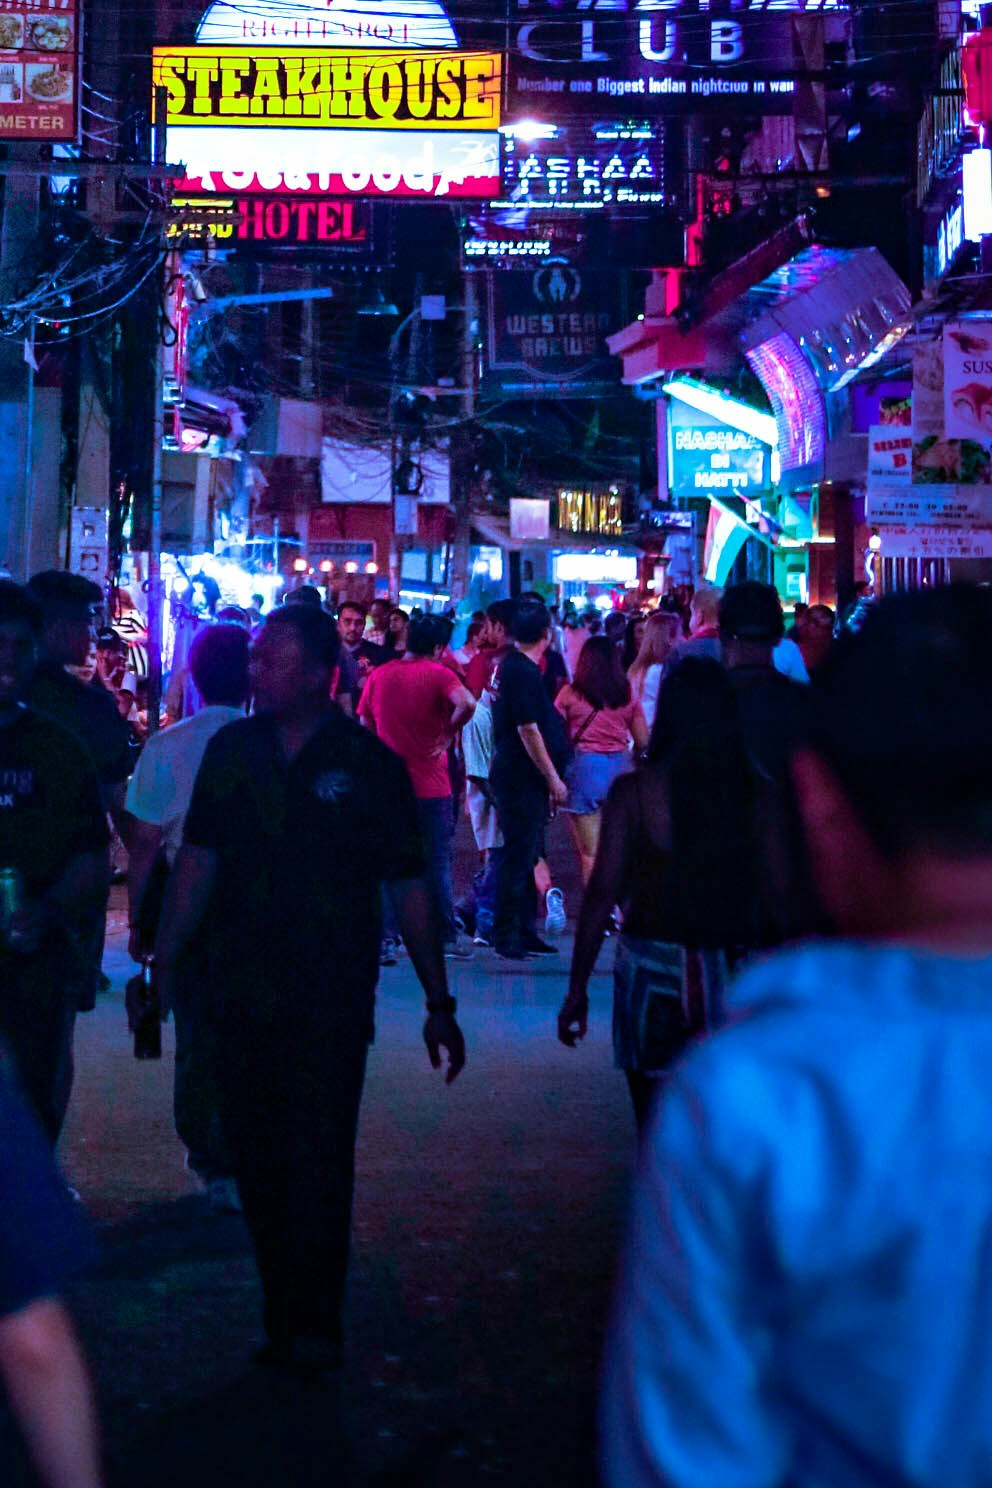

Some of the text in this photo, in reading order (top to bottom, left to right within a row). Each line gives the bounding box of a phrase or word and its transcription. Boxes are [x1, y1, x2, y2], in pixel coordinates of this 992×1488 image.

[517, 20, 743, 62] CLUB
[569, 81, 592, 92] one
[597, 77, 645, 96] Biggest
[648, 76, 687, 94] Indian
[238, 200, 366, 242] HOTEL
